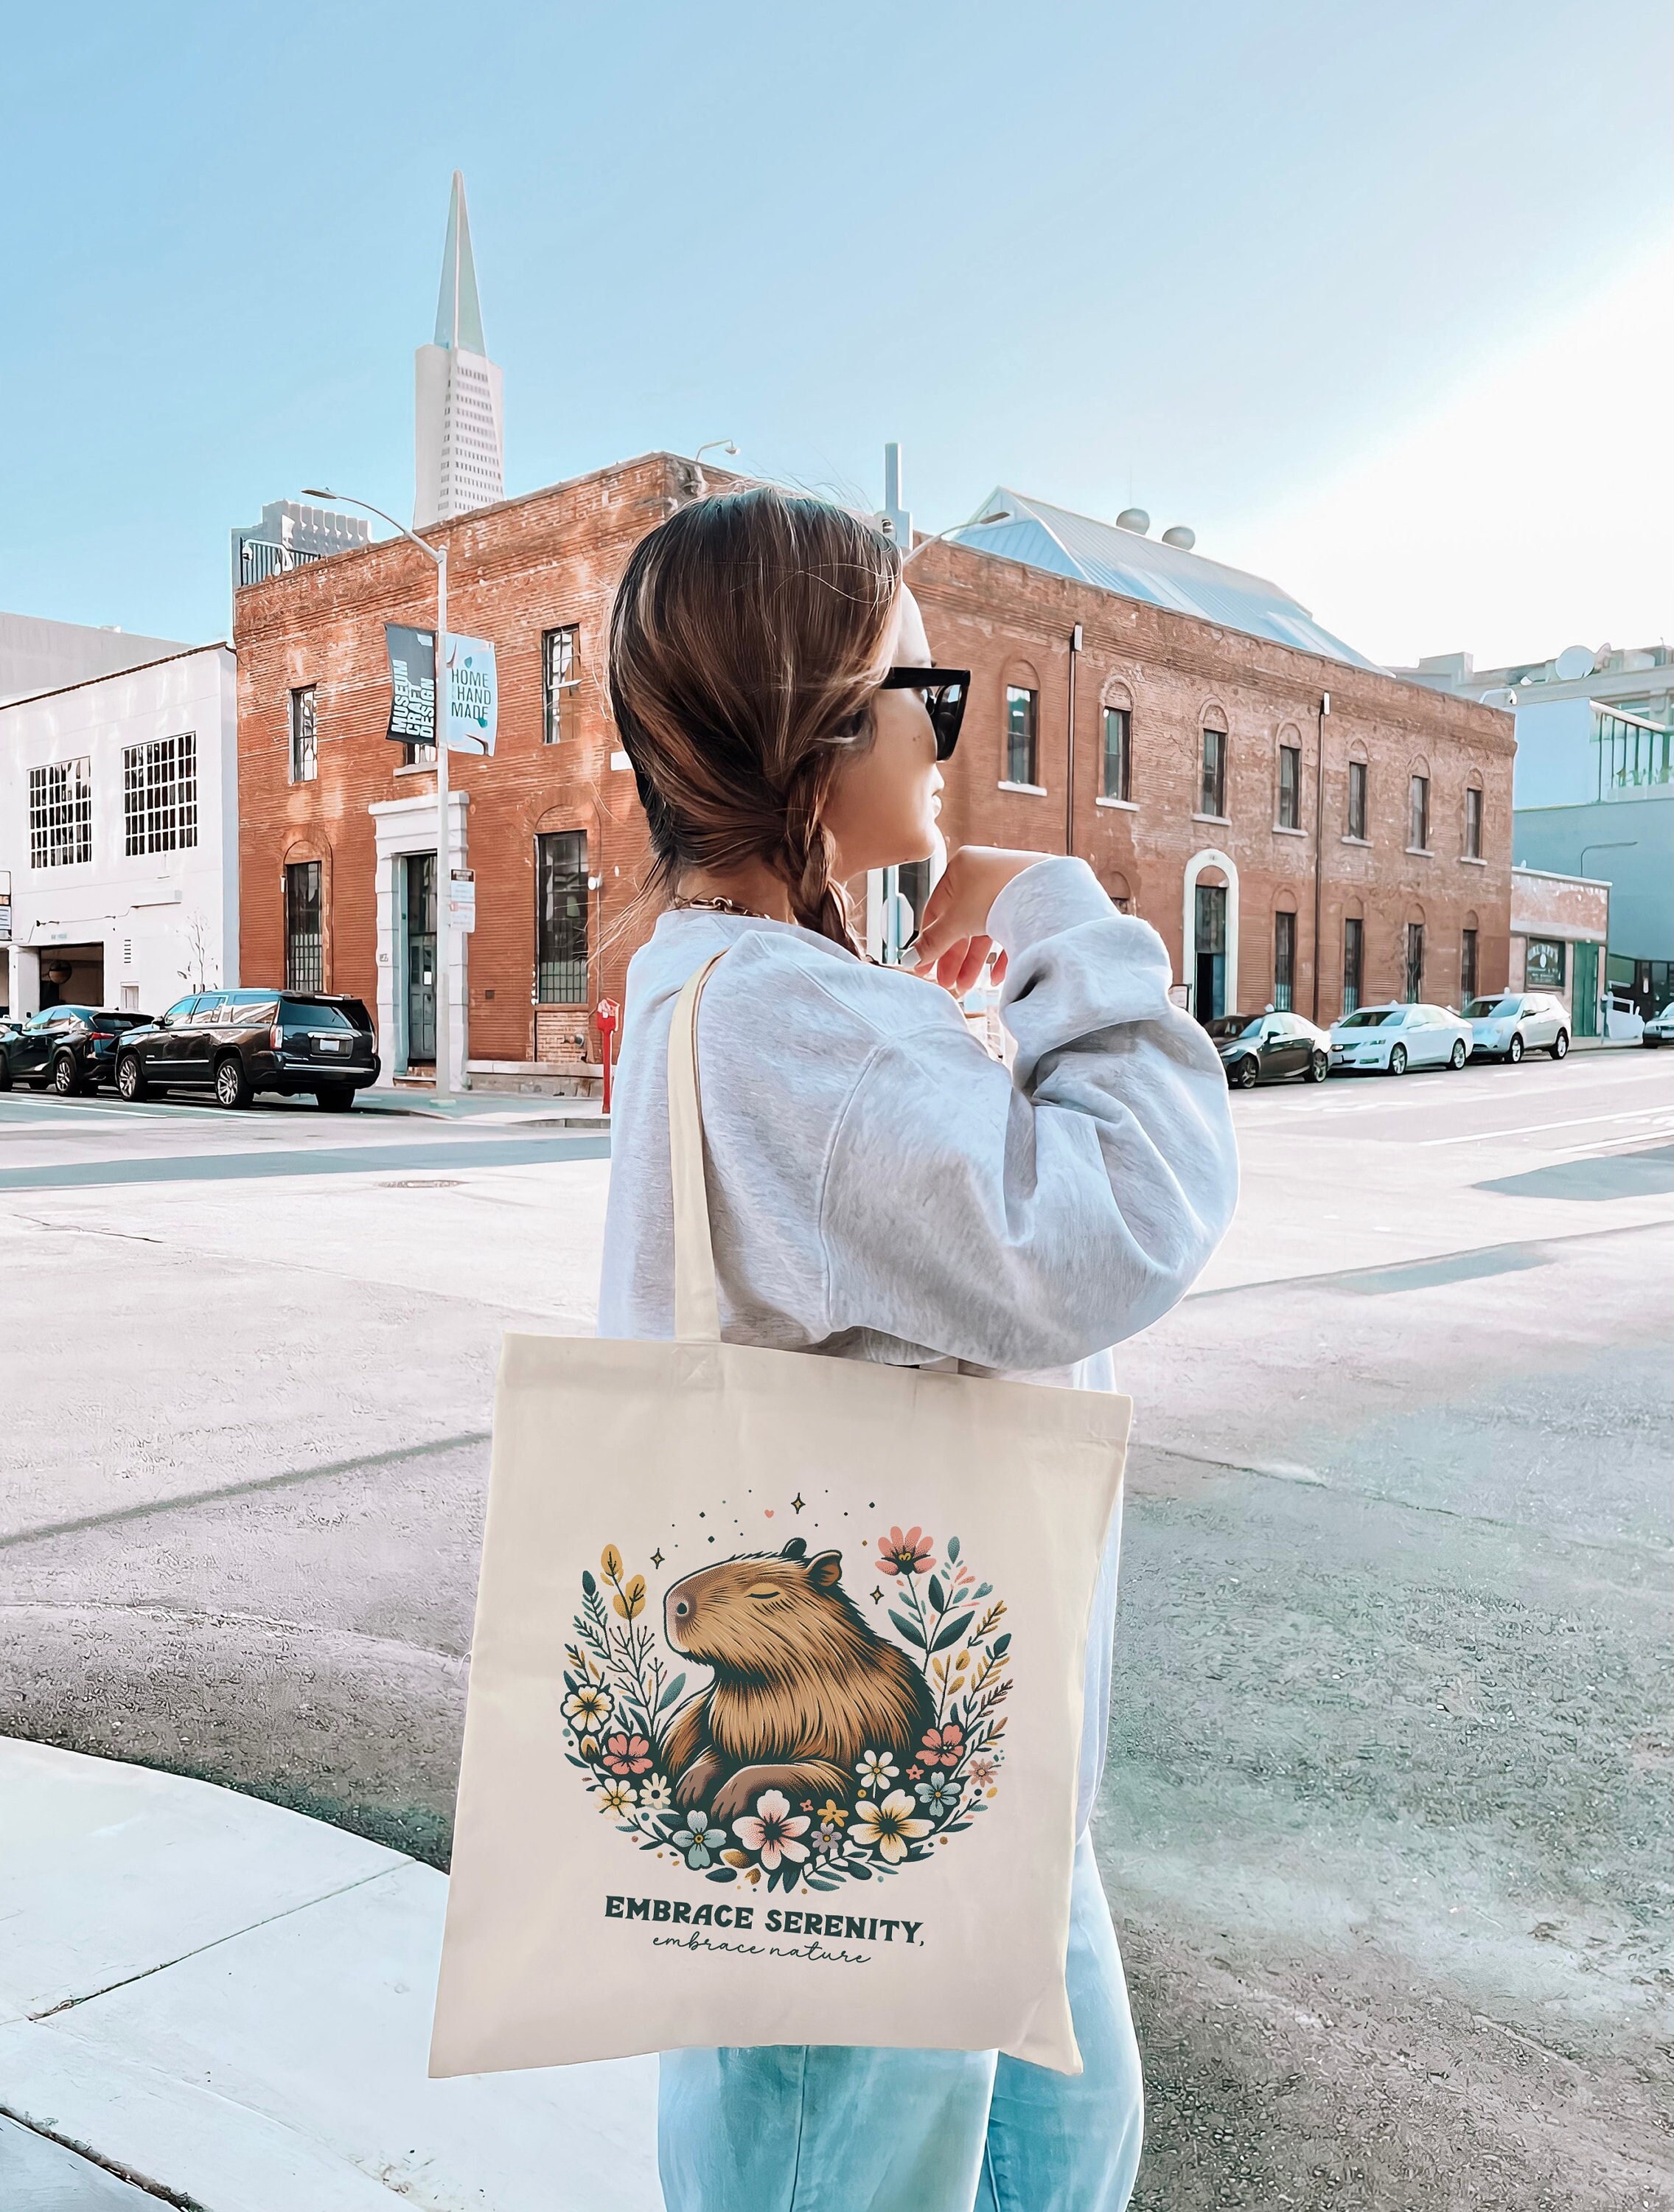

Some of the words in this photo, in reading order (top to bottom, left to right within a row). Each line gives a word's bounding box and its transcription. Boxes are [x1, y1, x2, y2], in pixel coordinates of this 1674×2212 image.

[391, 659, 408, 733] MUSEUM
[451, 669, 489, 689] HOME
[457, 686, 492, 705] HAND
[406, 682, 422, 736] CRAFT
[419, 678, 435, 737] DESIGN
[451, 702, 489, 720] MADE
[604, 1895, 754, 1930] EMBRACE
[764, 1909, 924, 1947] SERENITY,
[652, 1930, 766, 1954] embrace
[769, 1941, 871, 1964] nature
